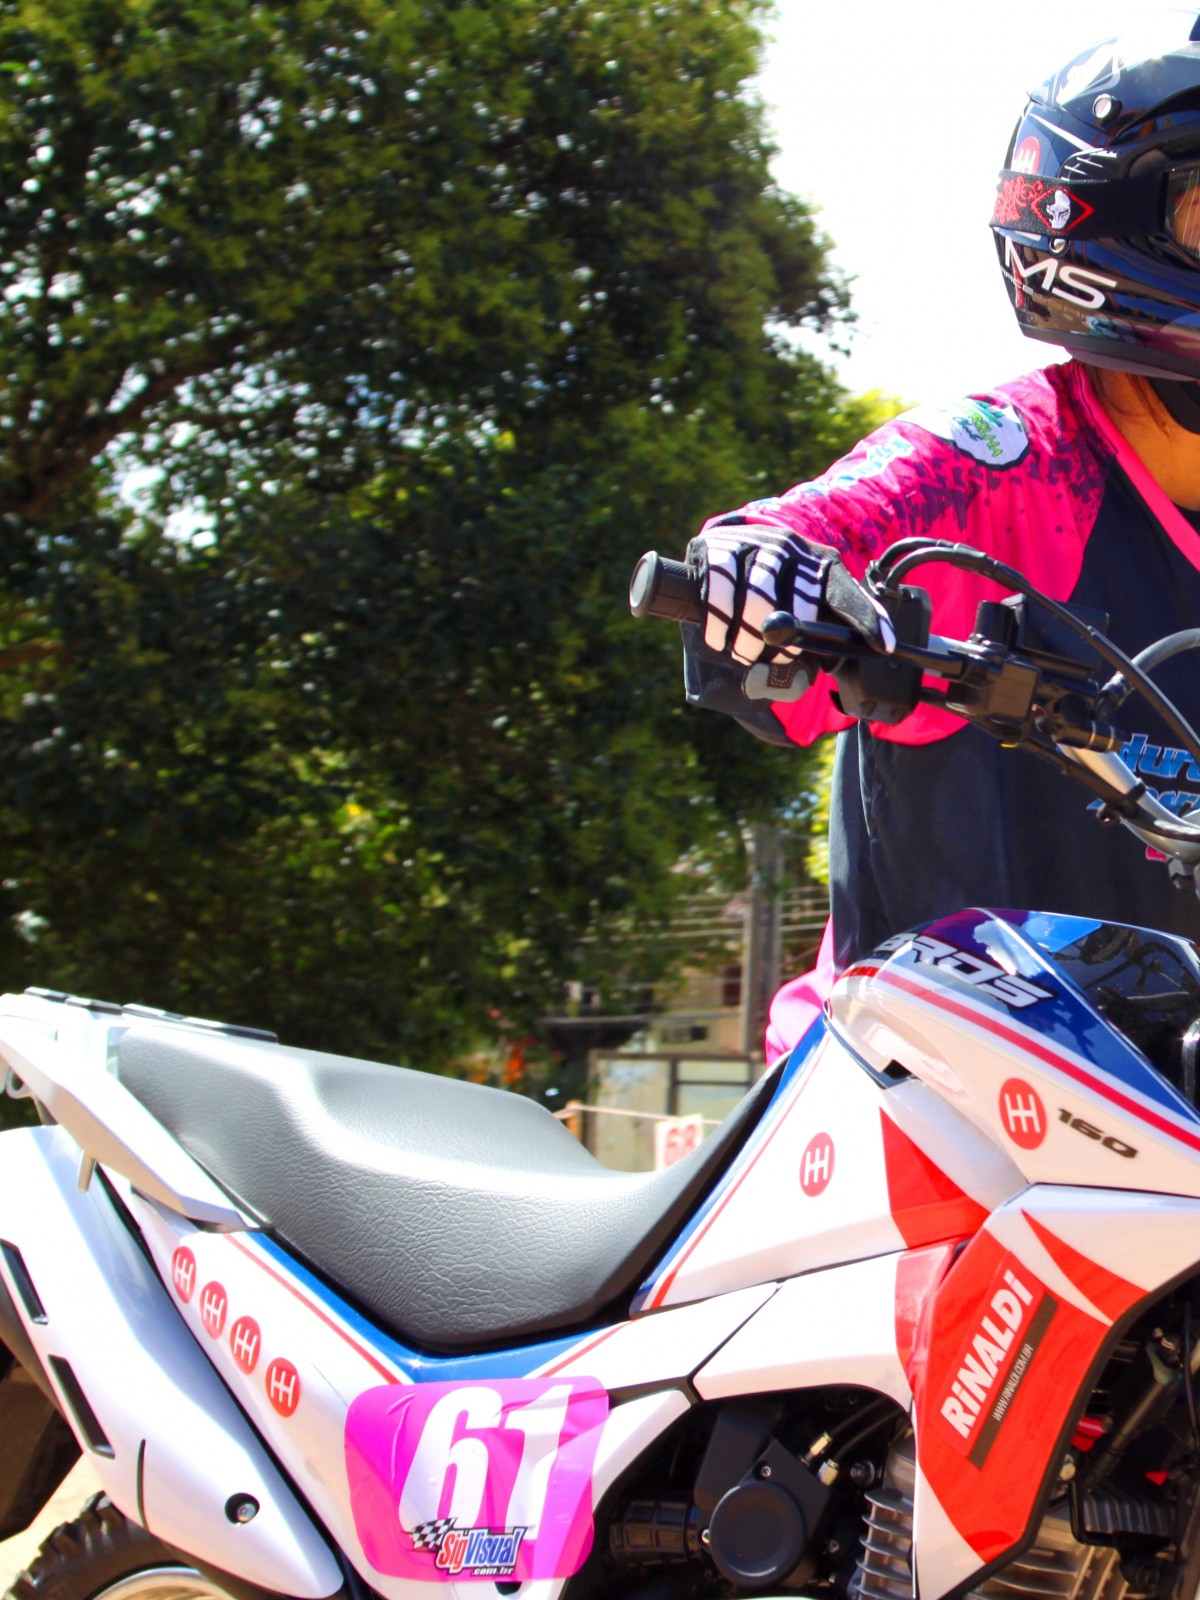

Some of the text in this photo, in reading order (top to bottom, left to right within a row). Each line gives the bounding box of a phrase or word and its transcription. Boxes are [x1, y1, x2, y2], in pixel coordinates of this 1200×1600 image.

[1057, 1107, 1138, 1158] 160
[398, 1384, 573, 1540] 61
[437, 1529, 524, 1573] SigVisual
